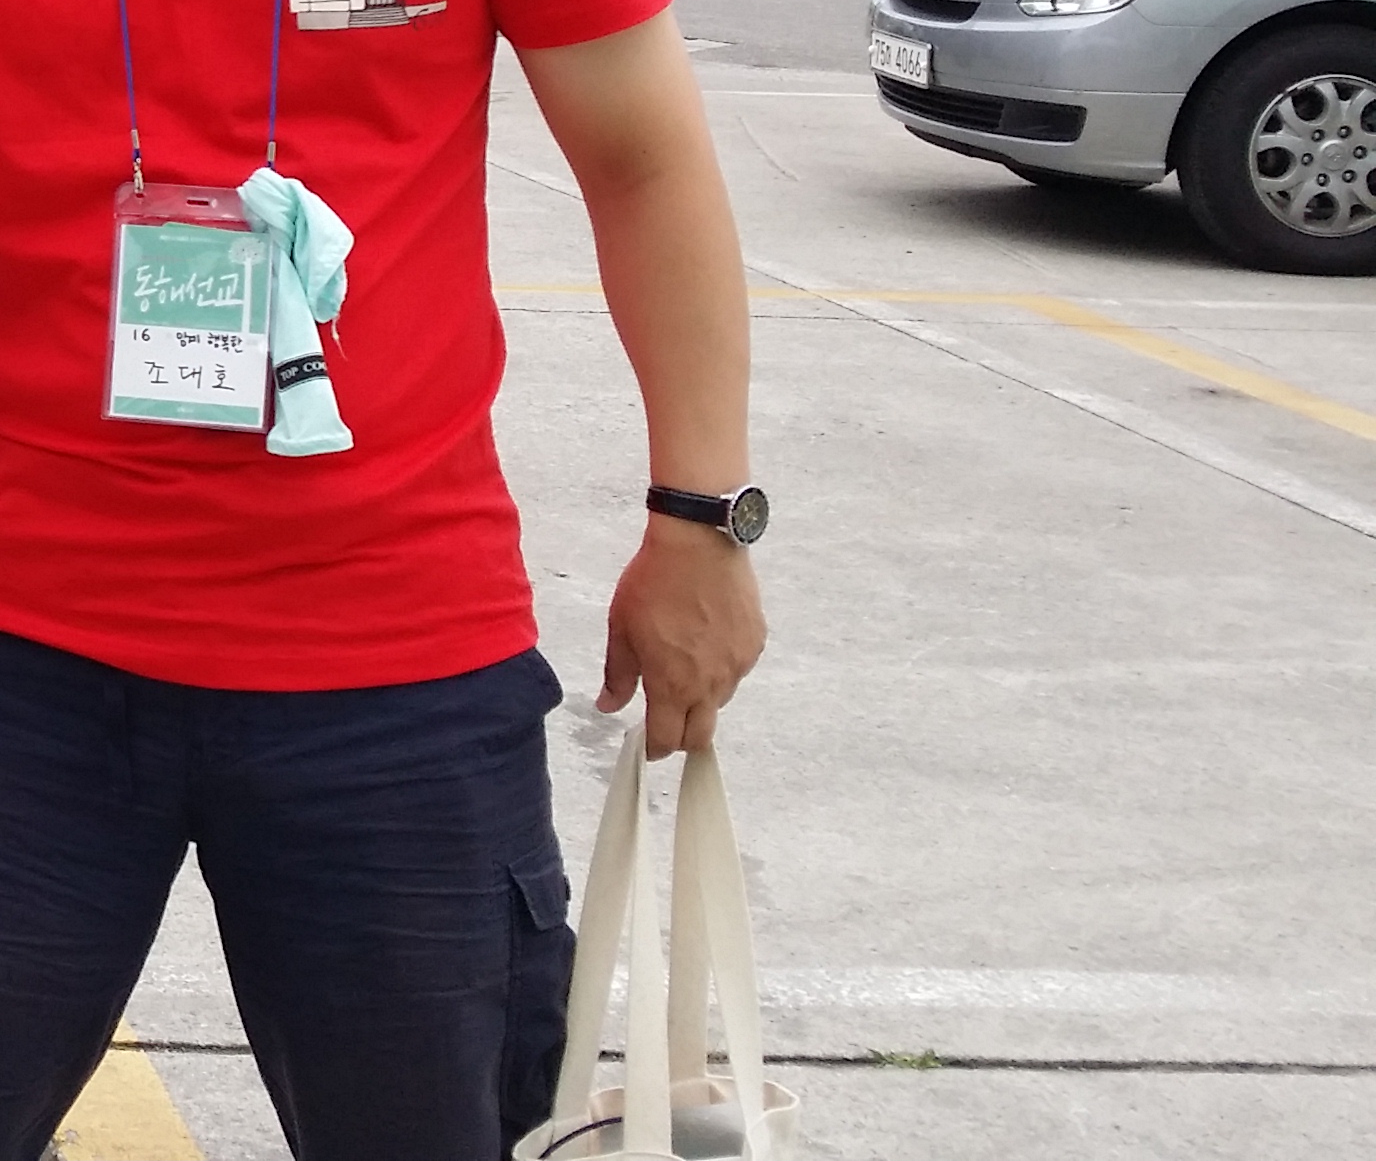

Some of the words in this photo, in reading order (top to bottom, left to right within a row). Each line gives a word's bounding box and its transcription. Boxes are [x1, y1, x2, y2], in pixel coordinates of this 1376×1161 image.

[896, 46, 922, 78] 4066
[134, 264, 245, 313] 동해선교
[133, 328, 151, 342] 16
[280, 366, 299, 382] TOP
